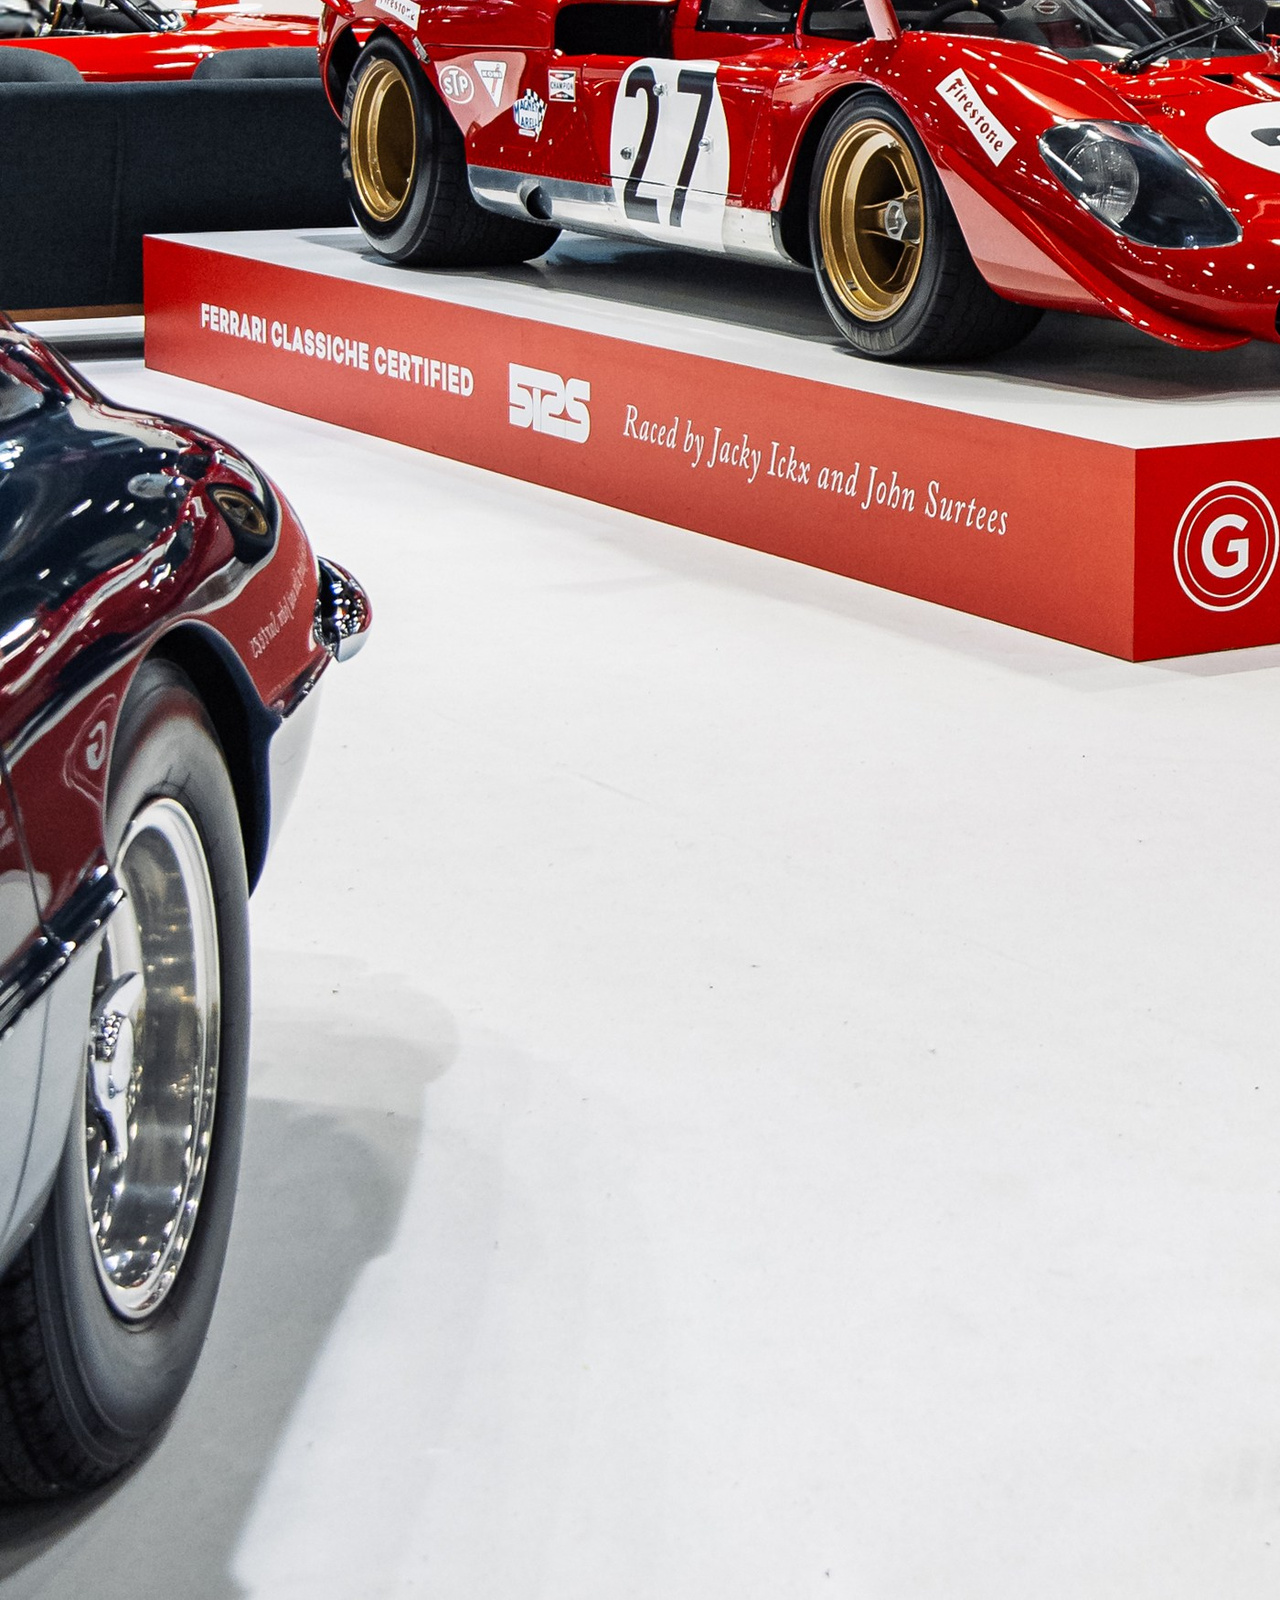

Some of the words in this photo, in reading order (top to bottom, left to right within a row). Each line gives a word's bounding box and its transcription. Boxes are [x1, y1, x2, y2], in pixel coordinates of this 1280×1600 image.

[443, 69, 469, 96] STP
[550, 81, 574, 90] CHAMPION
[945, 77, 1003, 152] Firestone
[623, 65, 717, 228] 27
[201, 302, 266, 345] FERRARI
[271, 321, 370, 372] CLASSICHE
[374, 346, 475, 397] CERTIFIED
[622, 403, 680, 450] Raced
[683, 419, 705, 469] by
[706, 426, 762, 484] Jacky
[766, 440, 811, 486] Ickx
[817, 461, 861, 498] and
[860, 465, 915, 513] John
[924, 479, 1009, 536] Surtees
[1201, 513, 1250, 580] G
